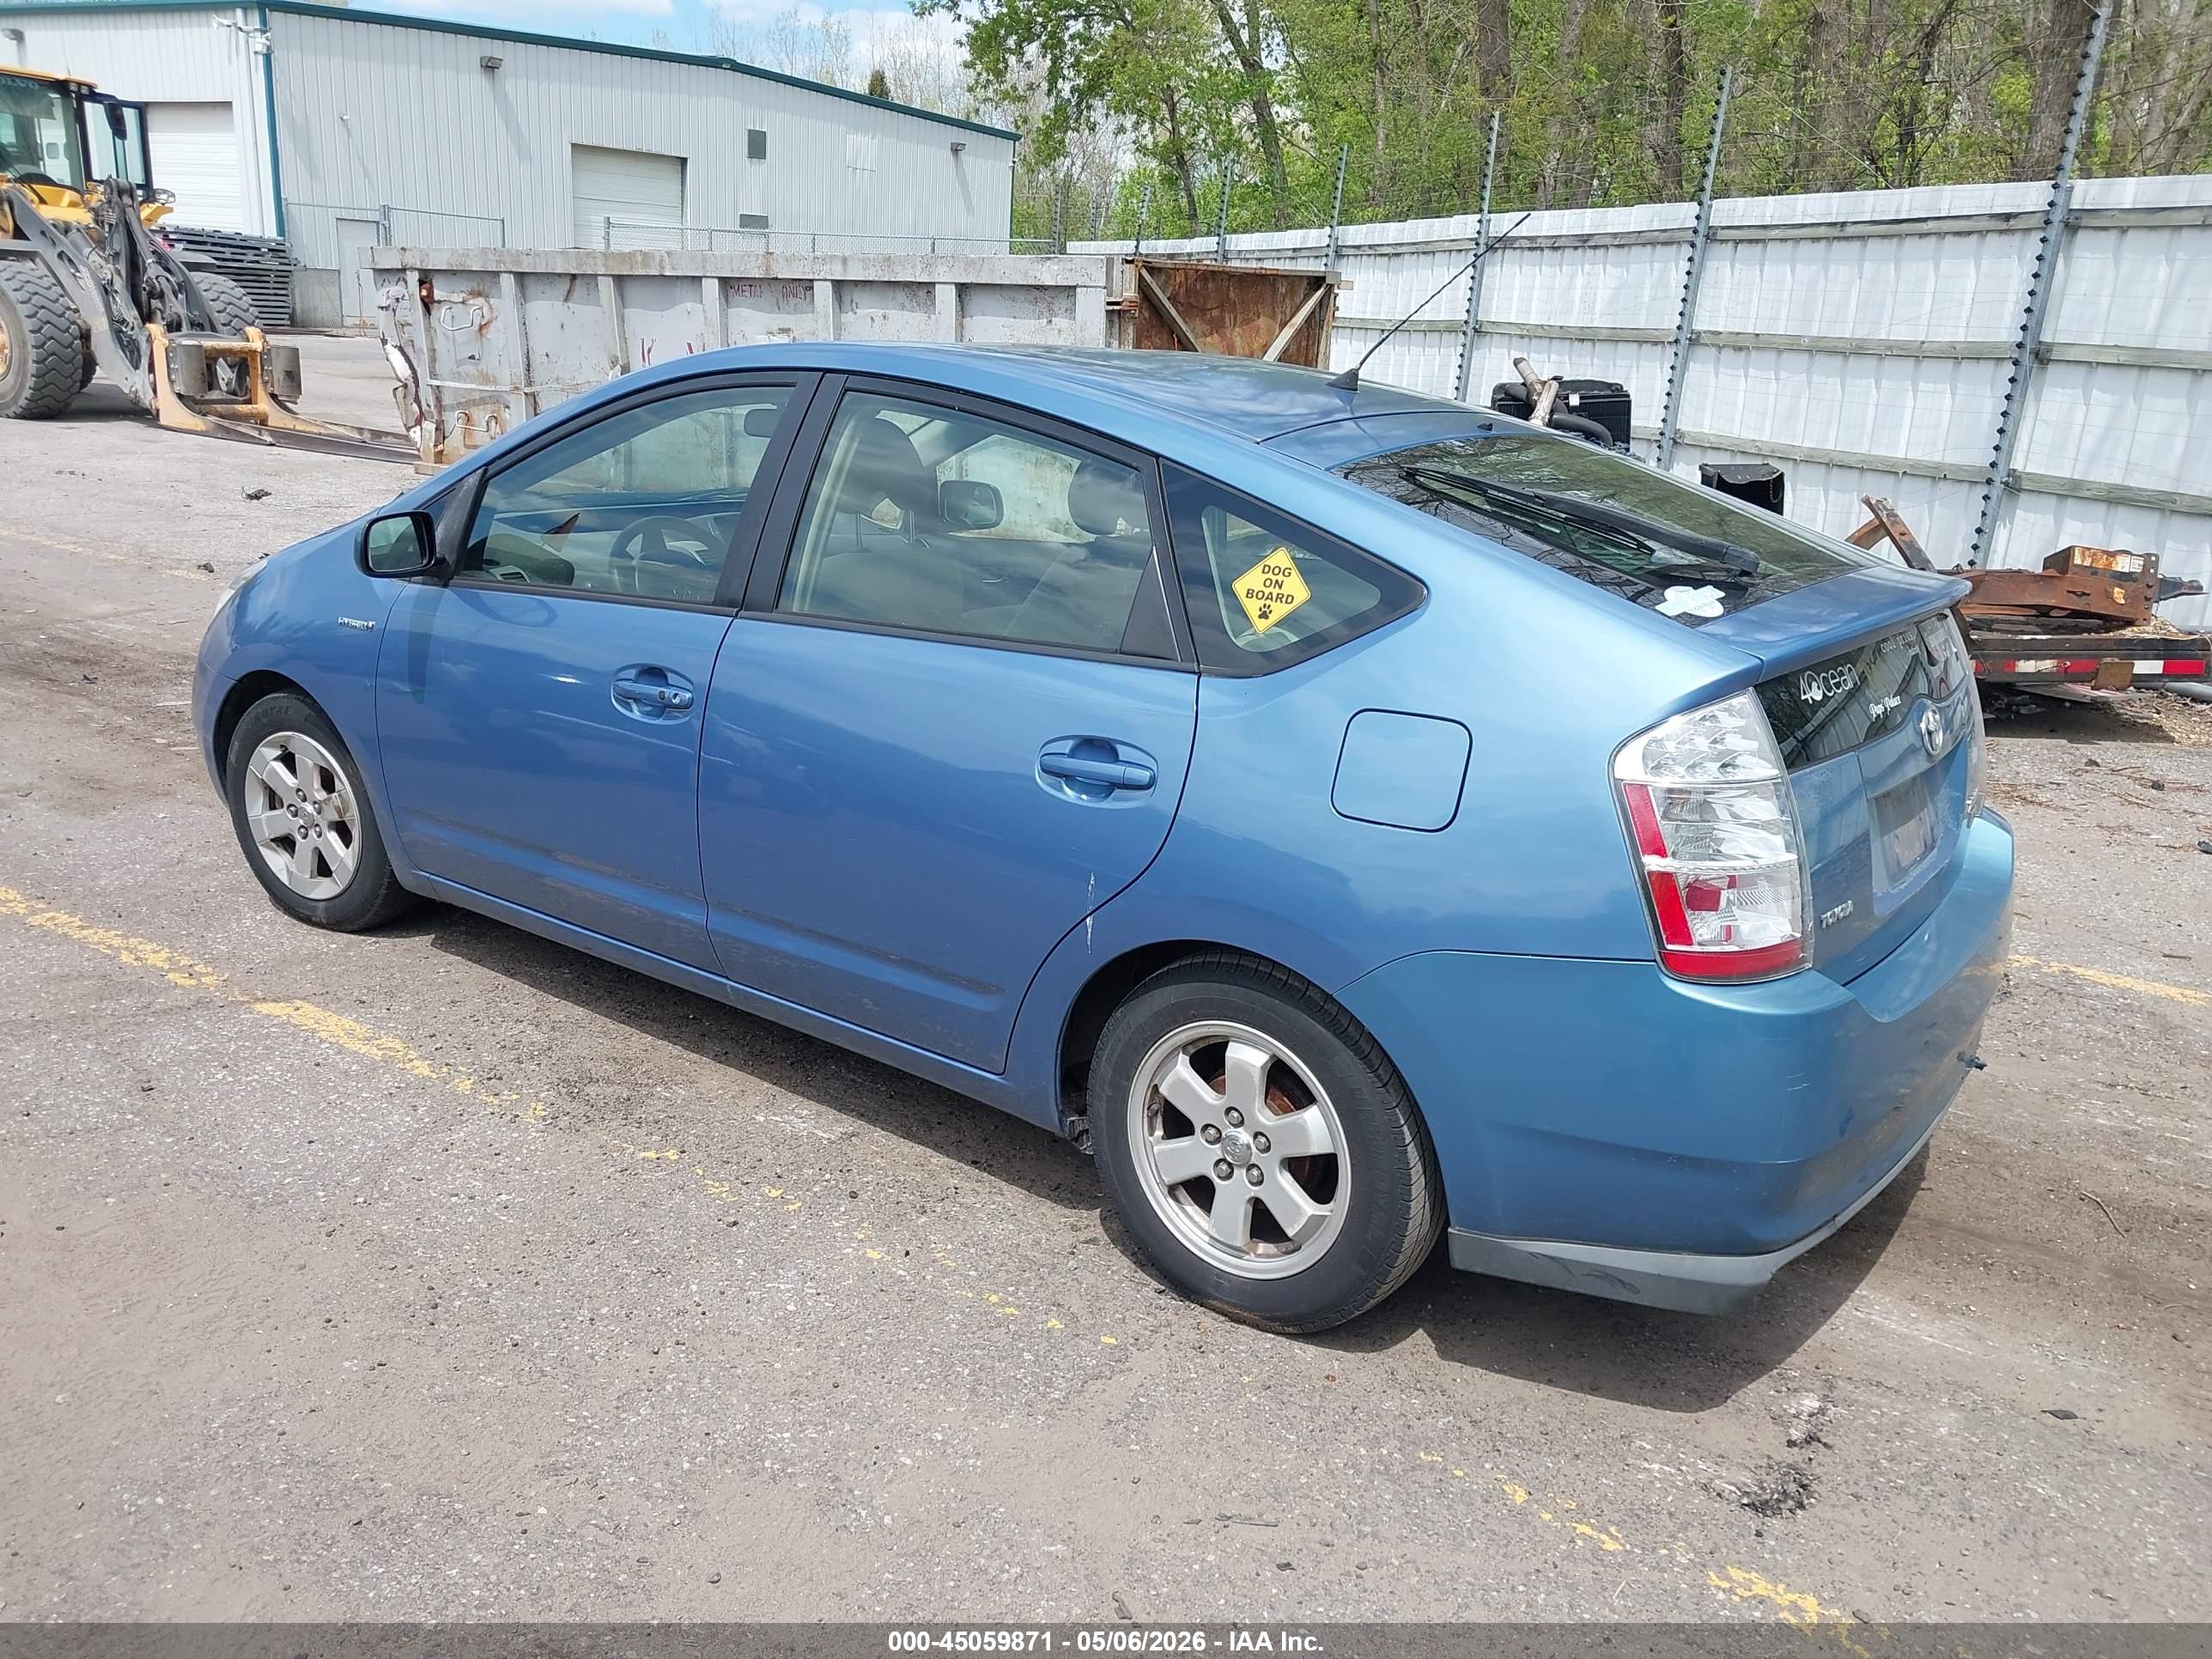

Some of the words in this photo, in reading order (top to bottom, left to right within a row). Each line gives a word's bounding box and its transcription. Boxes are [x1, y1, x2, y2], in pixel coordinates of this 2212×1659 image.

[1261, 564, 1292, 577] DOG
[1263, 578, 1284, 590] ON
[1245, 588, 1294, 605] BOARD
